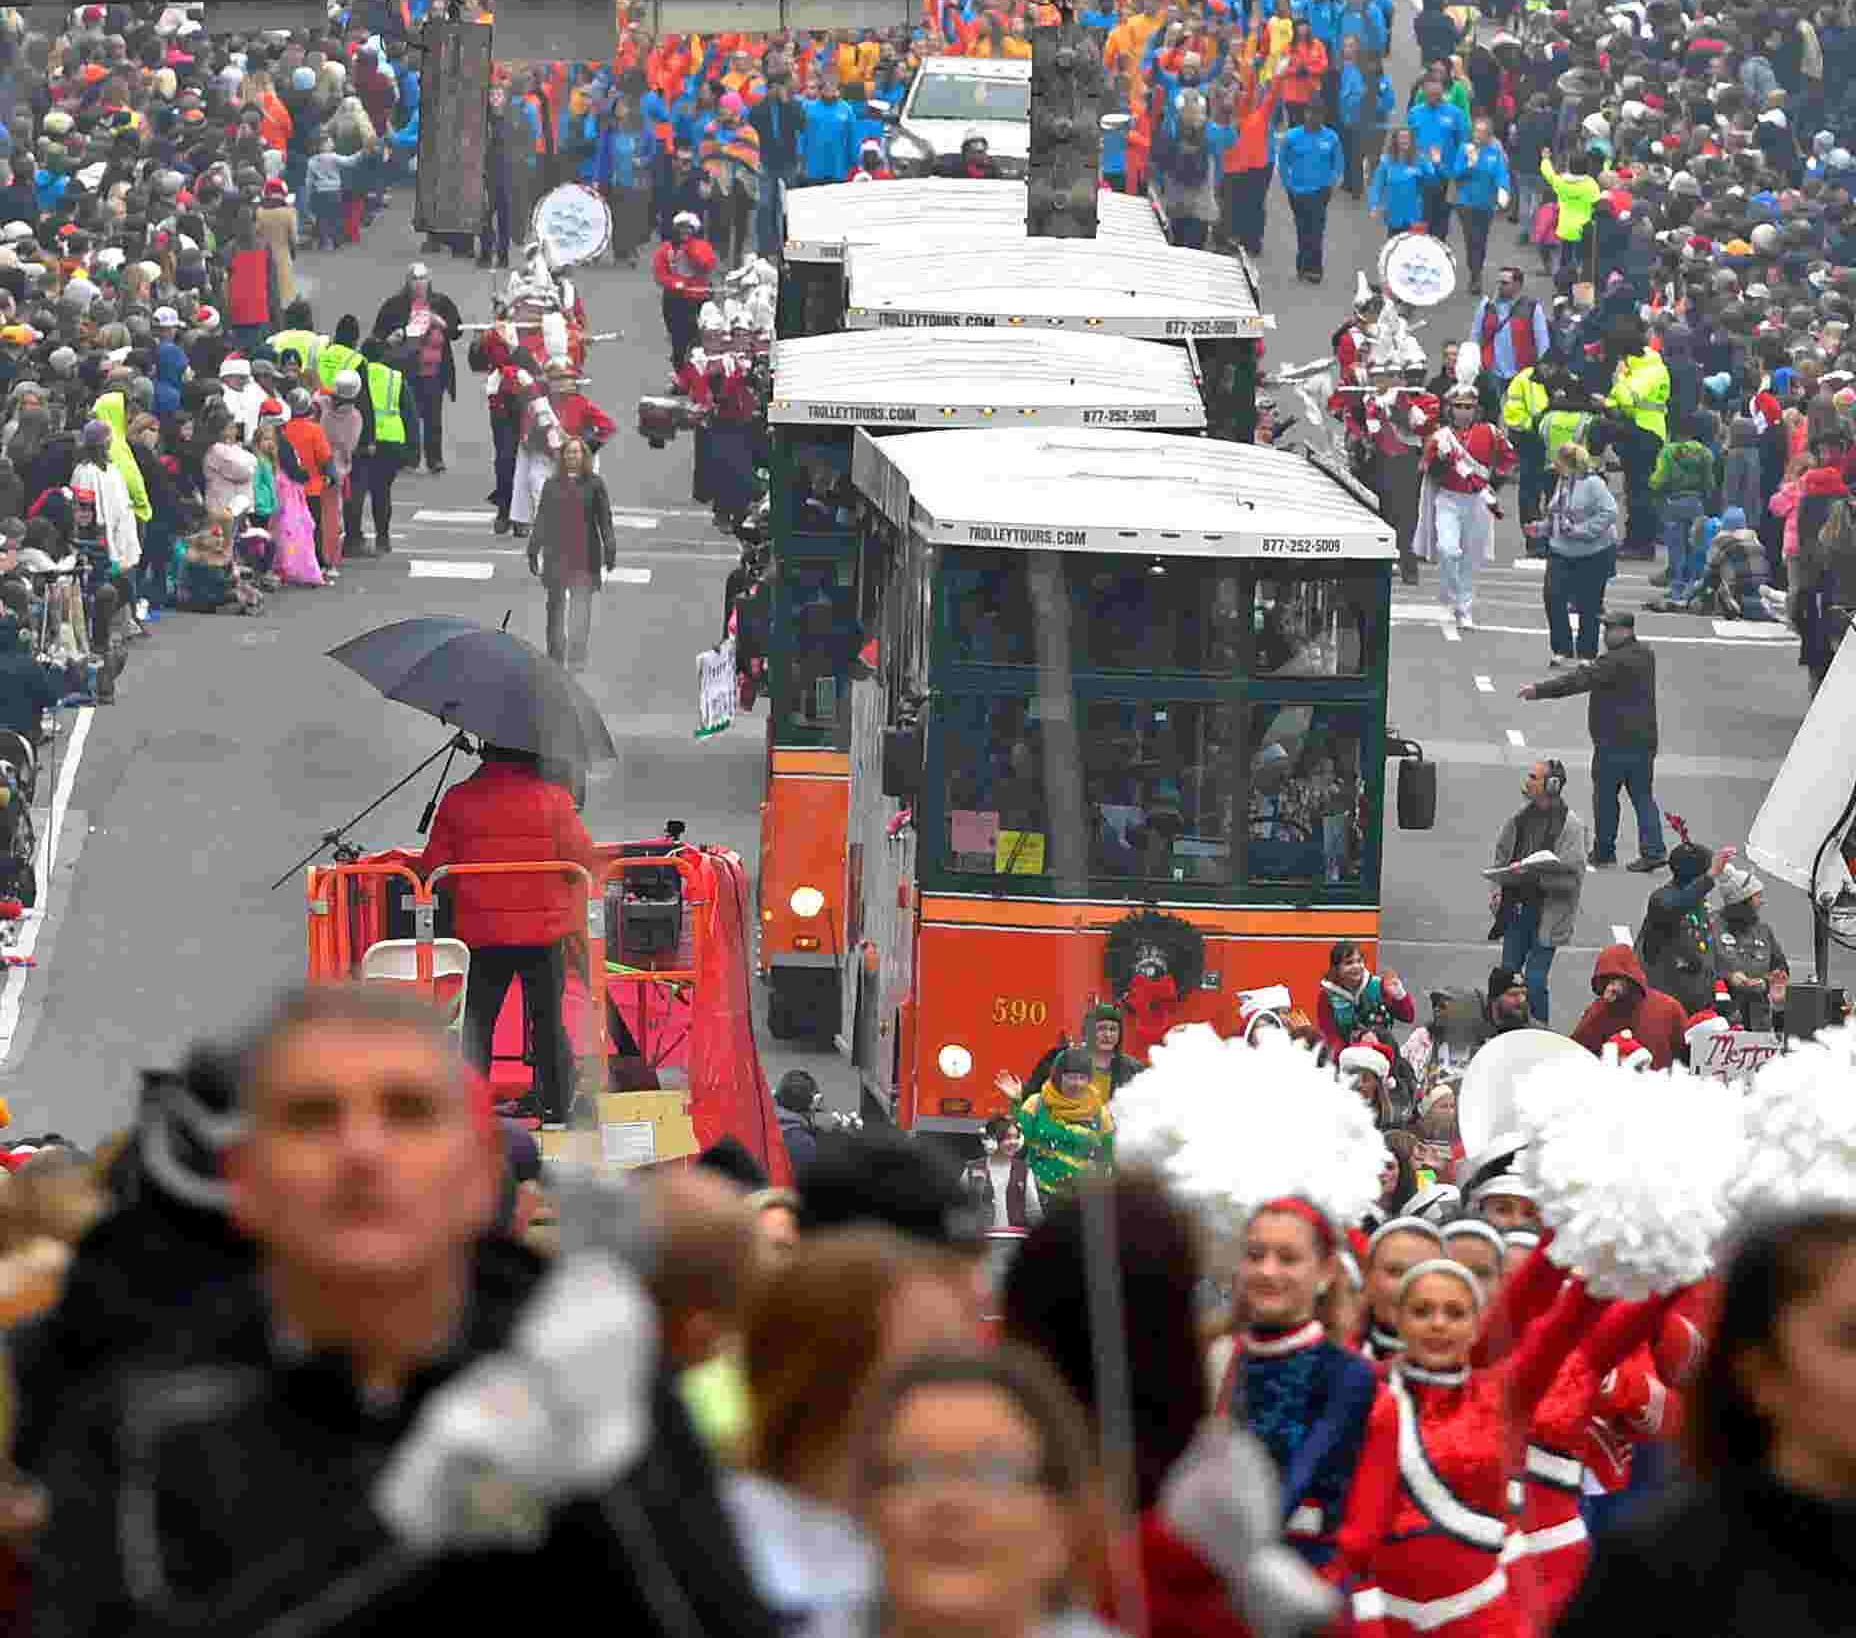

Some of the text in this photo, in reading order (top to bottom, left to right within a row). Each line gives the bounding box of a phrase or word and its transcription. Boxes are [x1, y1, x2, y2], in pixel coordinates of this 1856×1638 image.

[807, 405, 917, 422] TROLLEYTOURS.COM
[968, 525, 1342, 555] TROLLEYTOURS.COM 877-252-5009
[991, 995, 1050, 1028] 590
